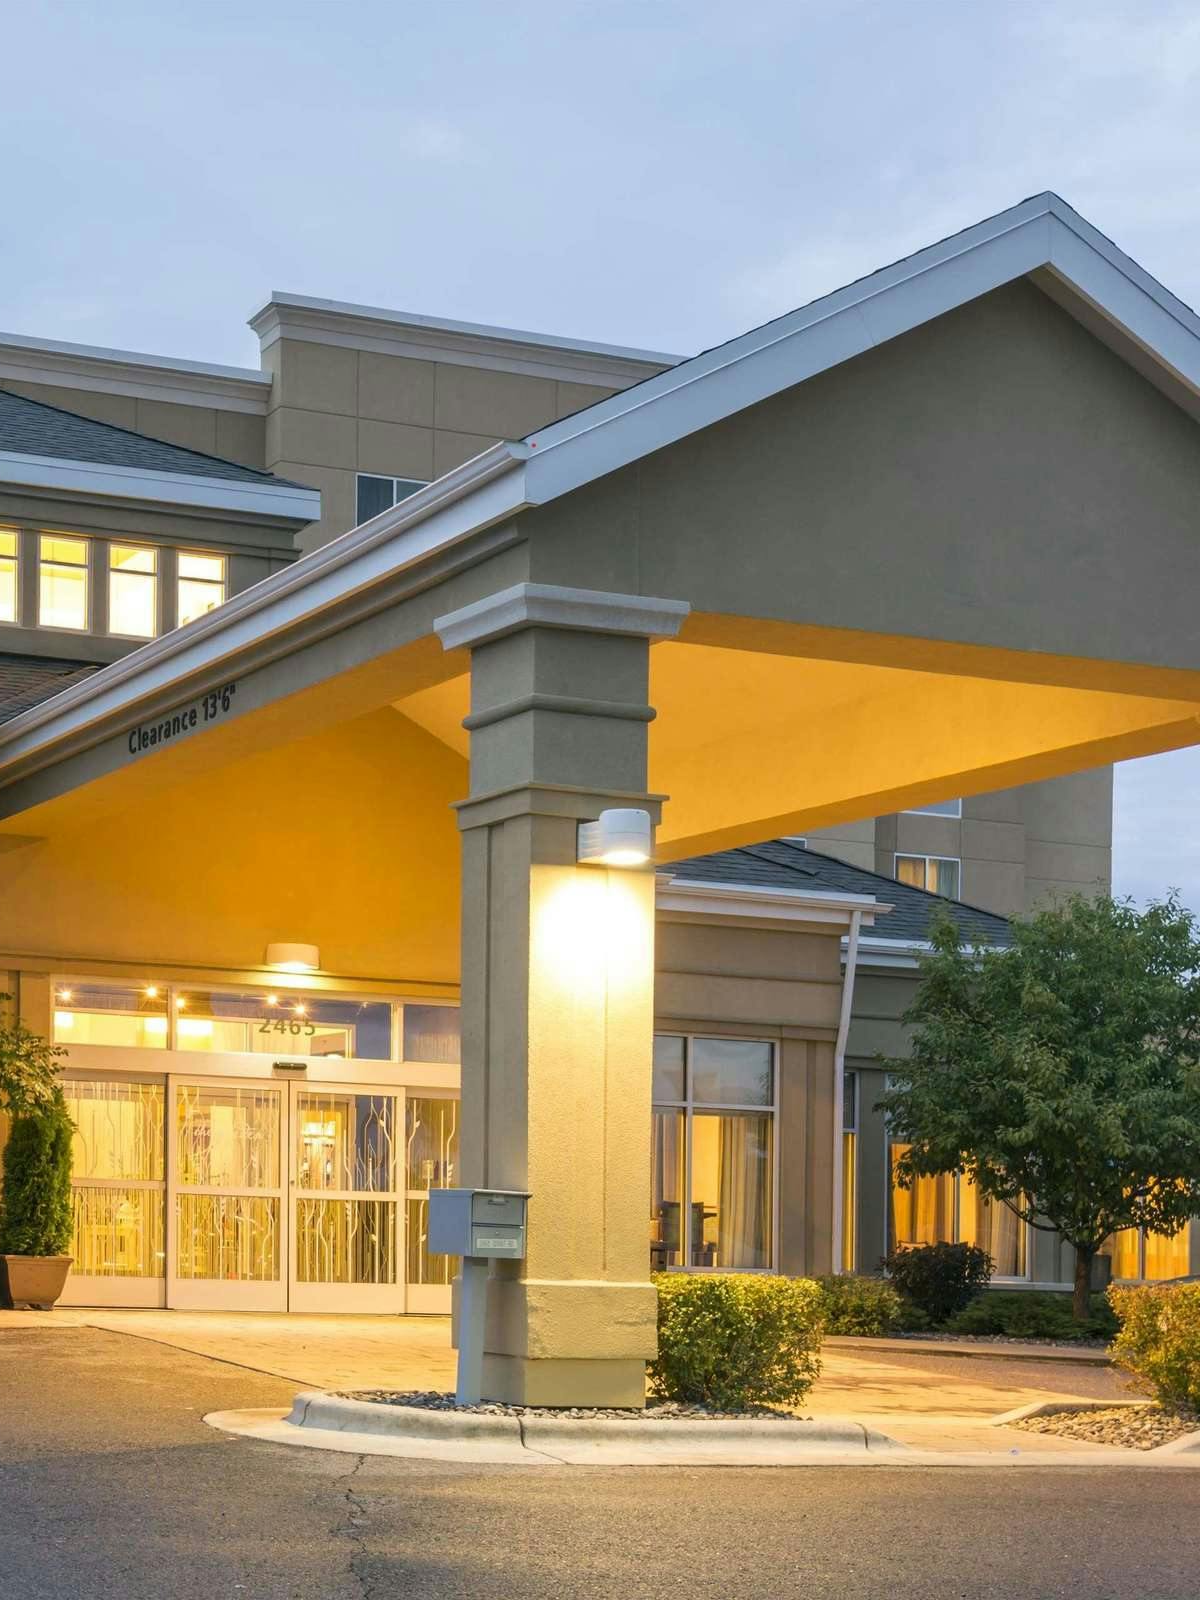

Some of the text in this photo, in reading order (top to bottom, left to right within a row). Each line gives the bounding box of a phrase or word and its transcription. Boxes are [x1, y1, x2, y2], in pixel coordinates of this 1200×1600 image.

[128, 684, 236, 754] Clearance 13'6"
[258, 1016, 316, 1036] 2465
